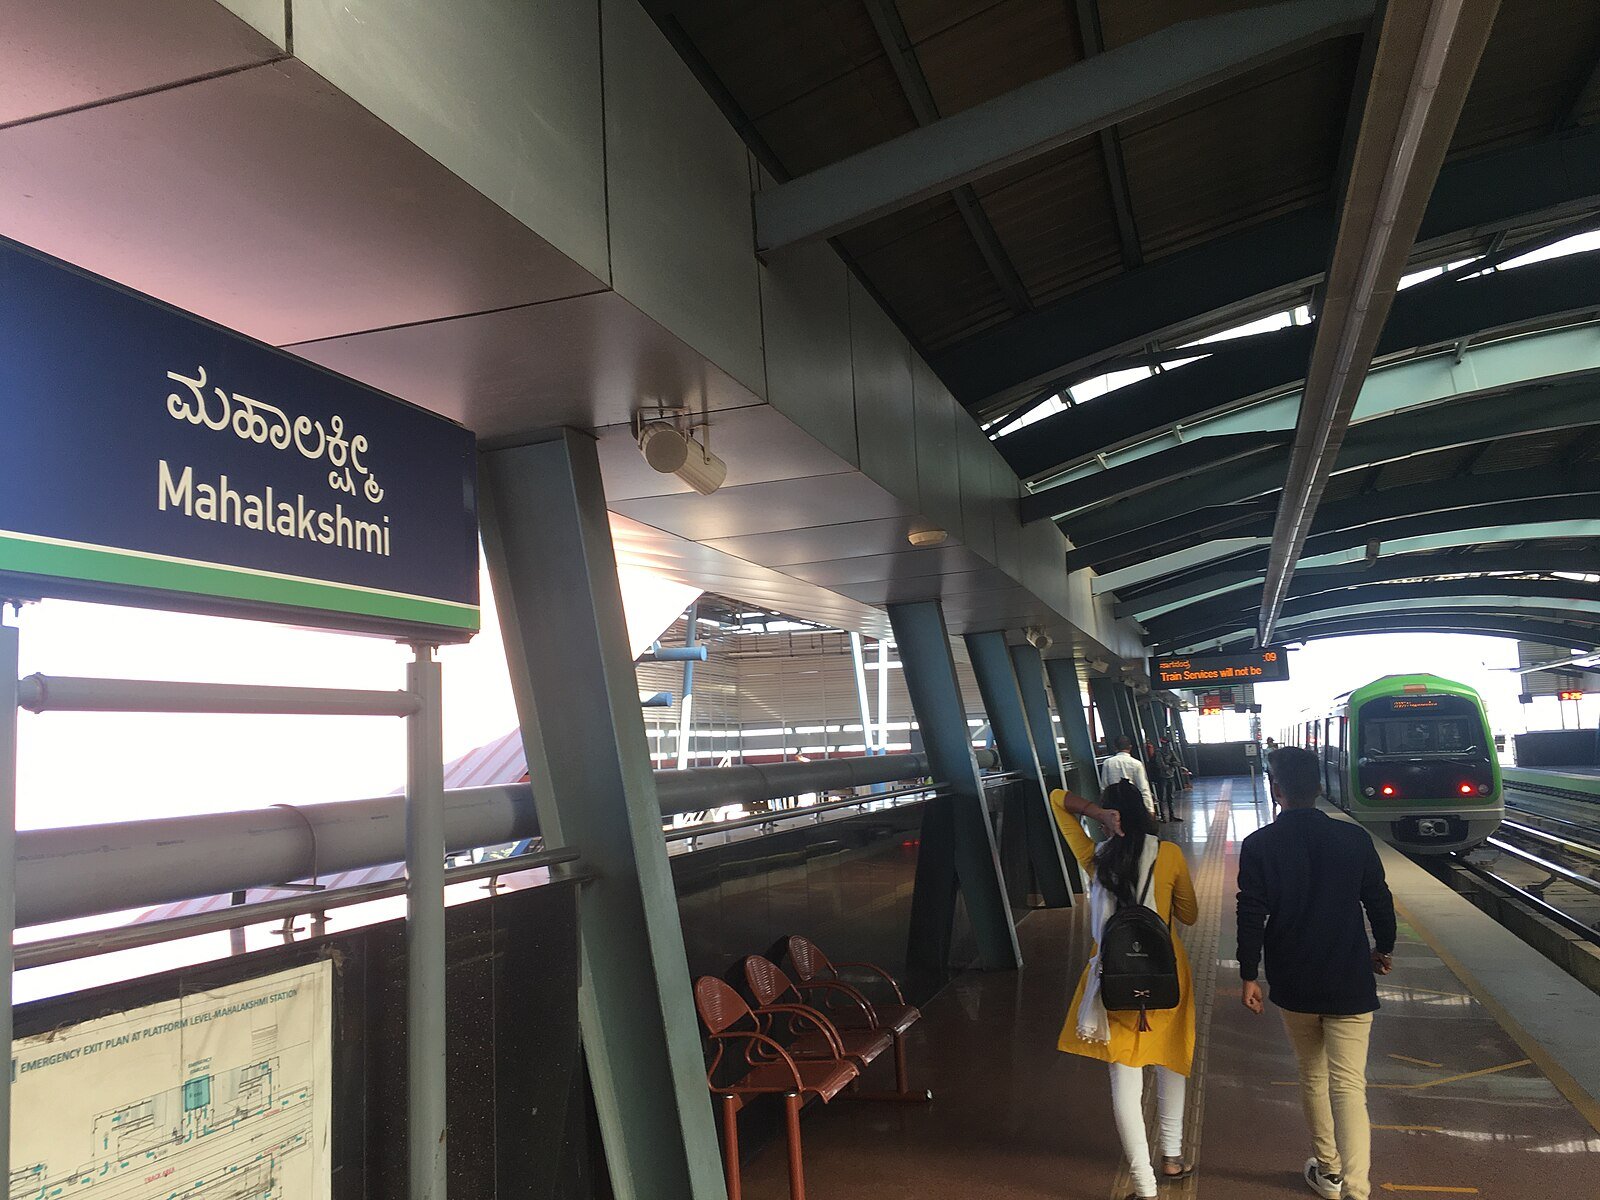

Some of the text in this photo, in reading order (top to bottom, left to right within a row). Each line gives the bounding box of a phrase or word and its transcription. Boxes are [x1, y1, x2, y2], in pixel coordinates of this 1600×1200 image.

[158, 459, 391, 556] Mahalakshmi
[1160, 666, 1262, 682] Train Services will not be
[20, 989, 298, 1073] EMERGENCY EXIT PLAN AT PLATFORM LEVEL-MAHALAKSHMI STATION
